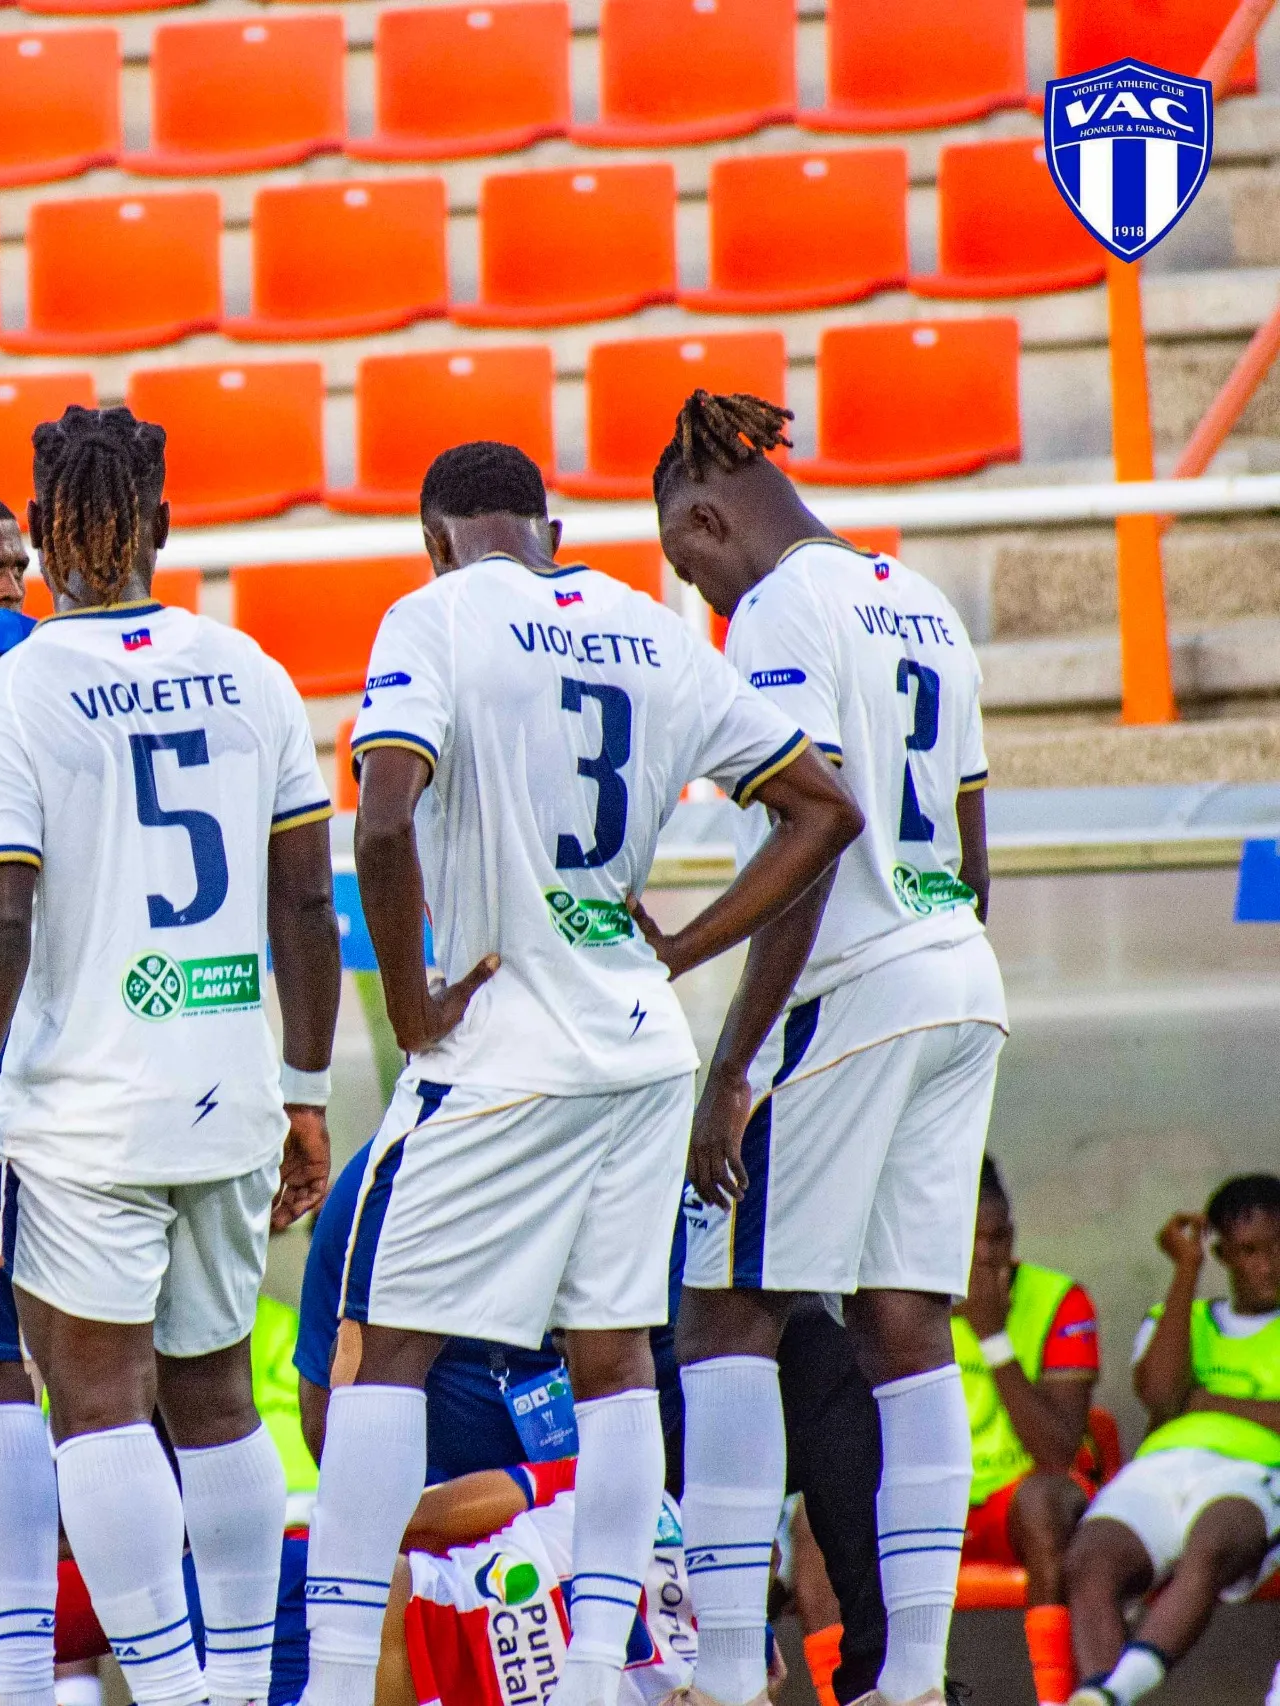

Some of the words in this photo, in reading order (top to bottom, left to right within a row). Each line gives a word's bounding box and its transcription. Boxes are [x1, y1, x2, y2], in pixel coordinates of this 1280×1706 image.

[510, 622, 661, 668] VIOLETTE
[70, 674, 241, 720] VIOLETTE
[555, 676, 632, 871] 3
[127, 728, 229, 929] 5
[191, 963, 253, 983] PARYAJ
[191, 981, 242, 1000] LAKAY
